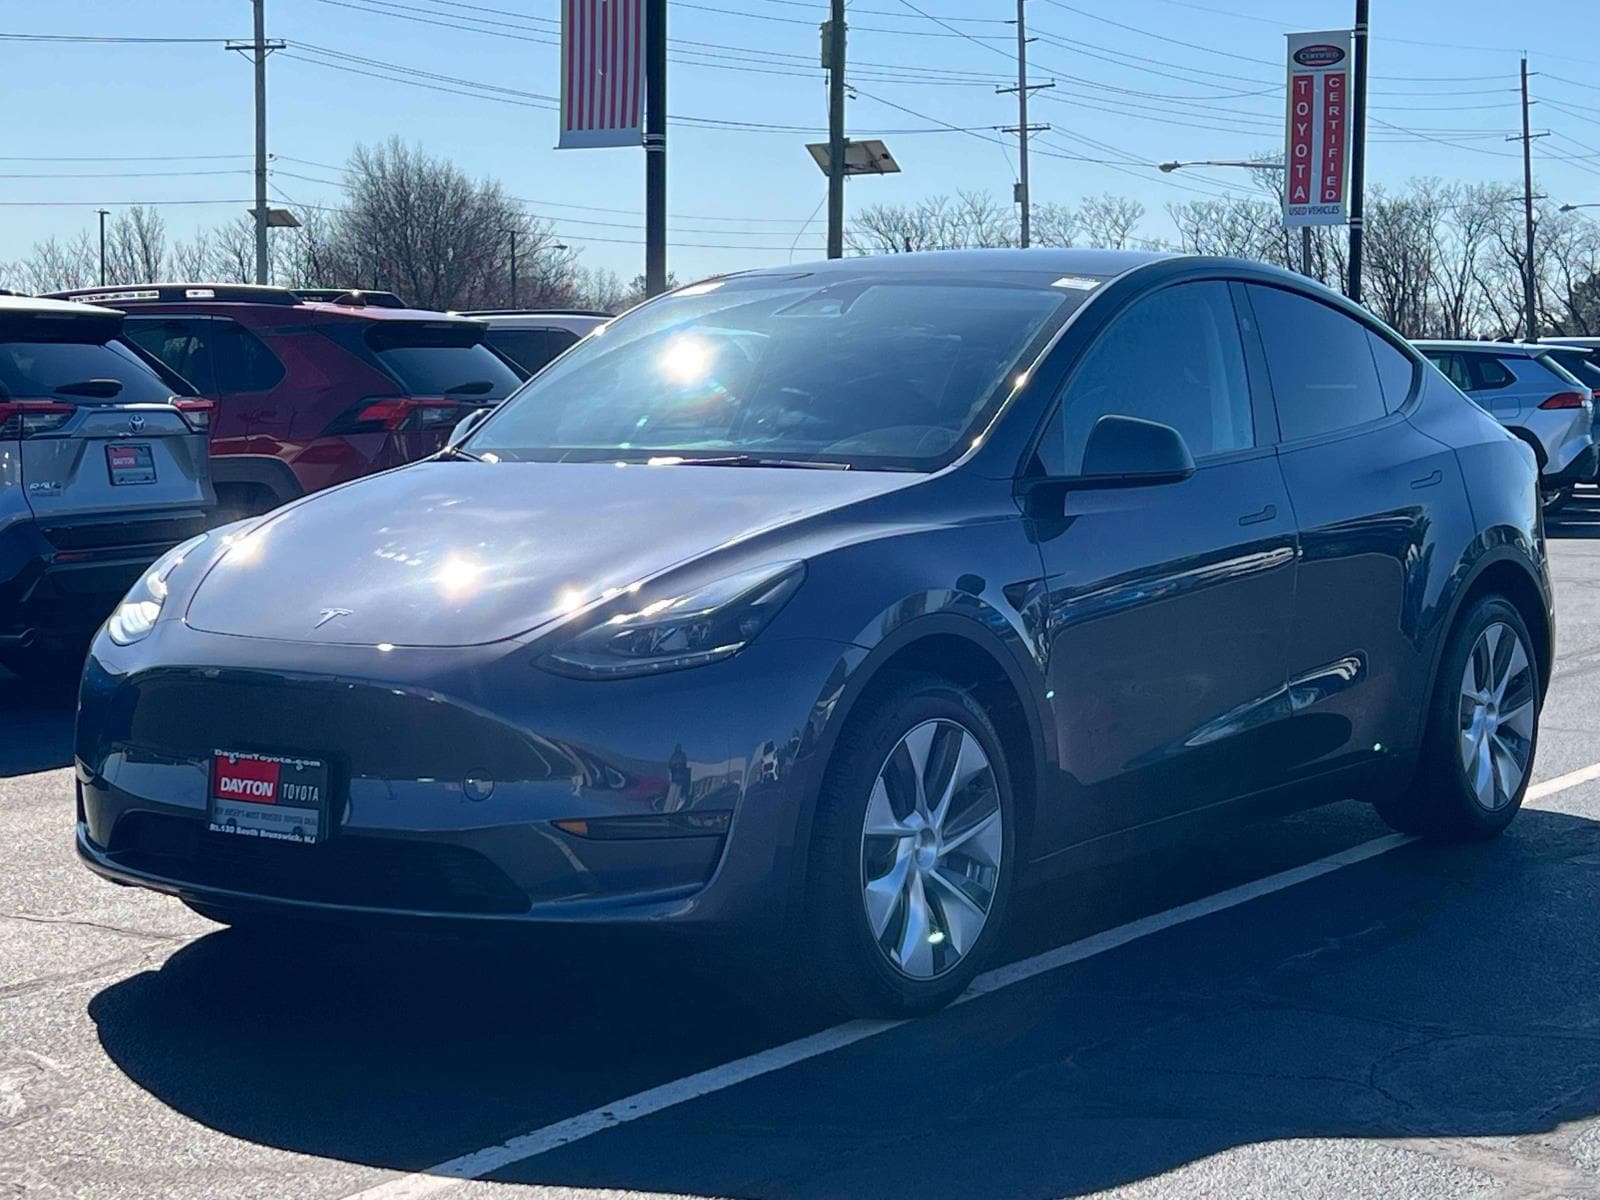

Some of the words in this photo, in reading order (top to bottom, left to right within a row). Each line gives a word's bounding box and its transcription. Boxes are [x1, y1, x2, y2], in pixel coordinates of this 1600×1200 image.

[1294, 80, 1309, 199] TOYOTA
[1325, 77, 1340, 200] CERTIFIED
[1289, 206, 1307, 216] USED
[1307, 205, 1340, 214] VEHICLES
[214, 748, 321, 767] DaytonToyota.com
[220, 777, 274, 797] DAYTON
[283, 783, 319, 801] TOYOTA
[236, 827, 258, 836] South
[304, 836, 316, 844] NJ
